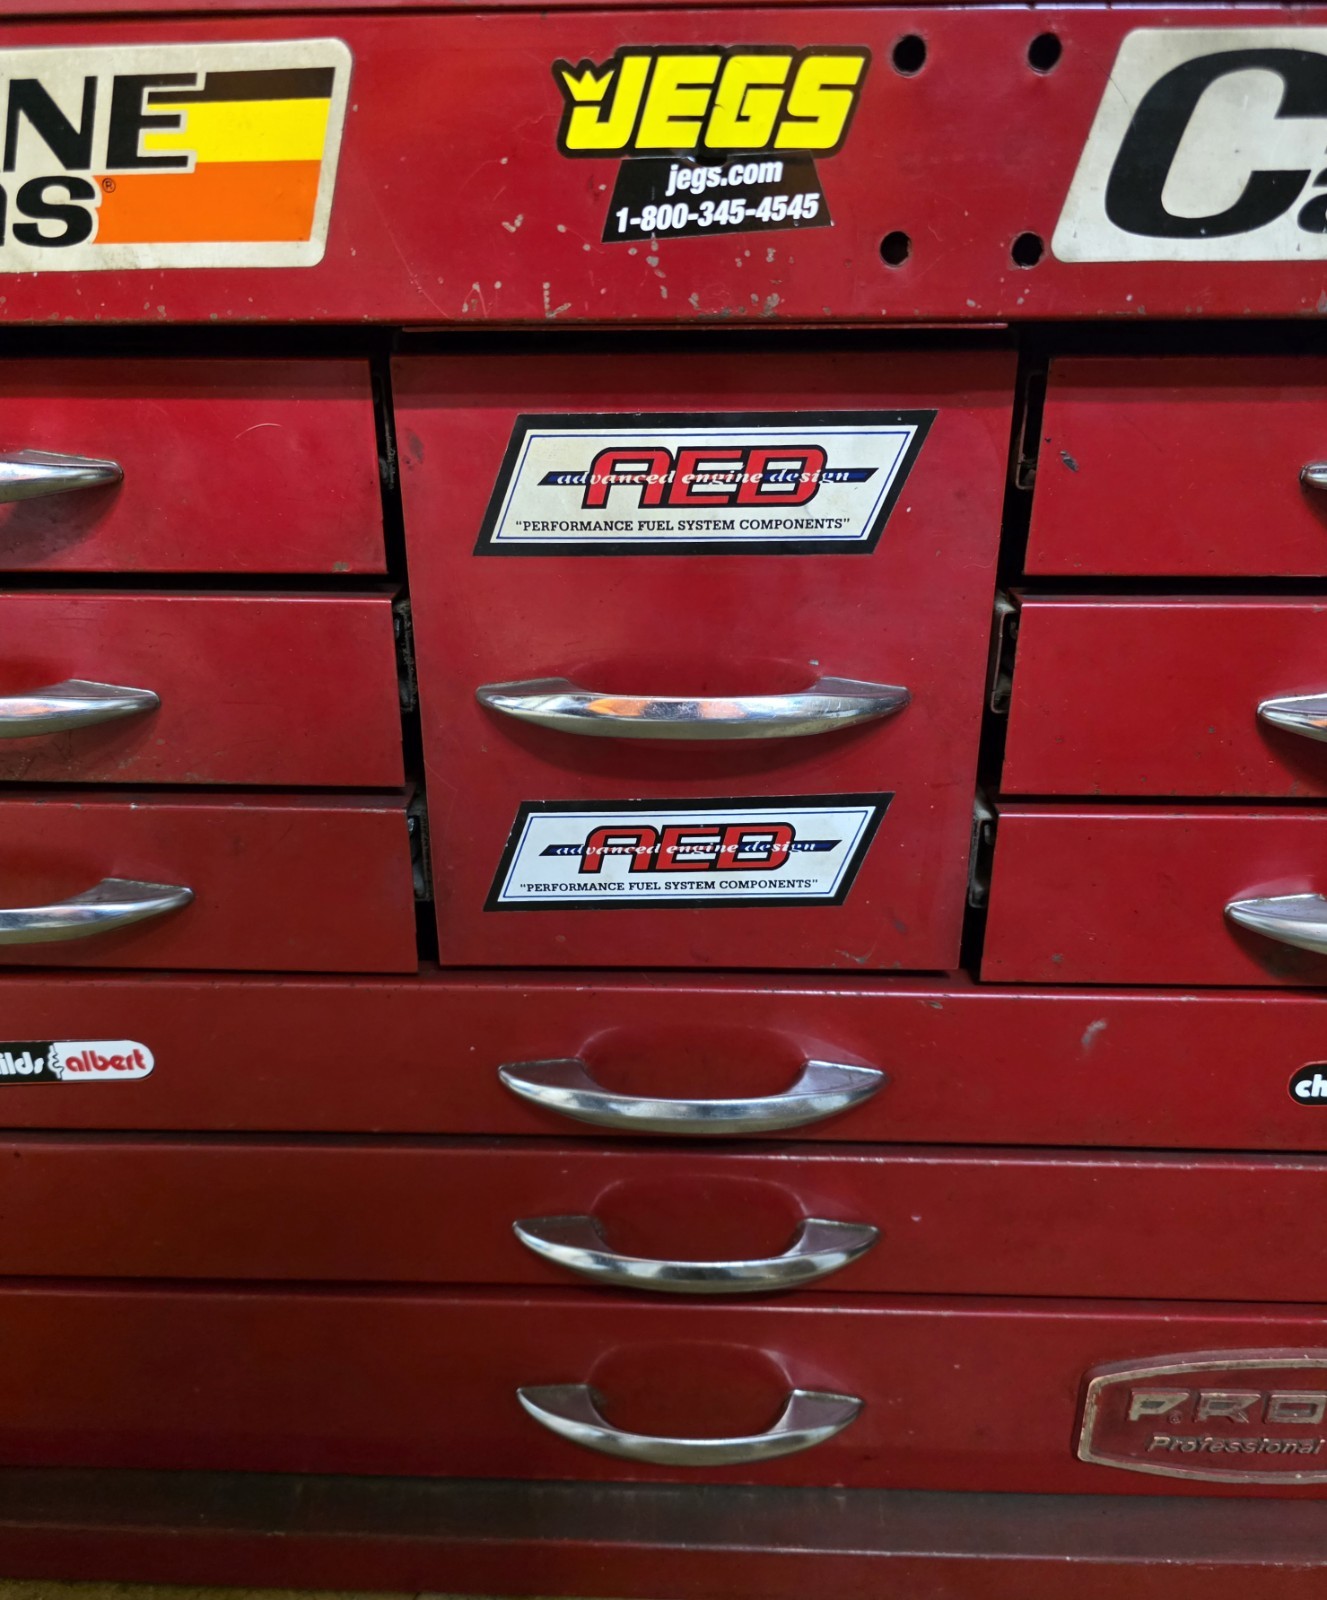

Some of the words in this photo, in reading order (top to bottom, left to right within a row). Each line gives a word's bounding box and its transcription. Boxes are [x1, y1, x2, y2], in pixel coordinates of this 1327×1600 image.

[566, 56, 865, 149] JEGS
[665, 161, 783, 196] jegs.com
[615, 193, 820, 233] 1-800-345-4545
[557, 470, 676, 485] advanced
[682, 470, 763, 485] engine
[769, 468, 850, 485] design
[581, 445, 828, 509] AED
[638, 520, 674, 531] FUEL
[678, 519, 735, 531] SYSTEM
[556, 843, 661, 855] advanced
[666, 842, 739, 855] engine
[744, 840, 816, 853] design
[578, 822, 796, 874] AED
[629, 881, 661, 891] FUEL
[664, 880, 716, 890] SYSTEM
[65, 1049, 146, 1072] albert
[1148, 1434, 1326, 1455] Professional
